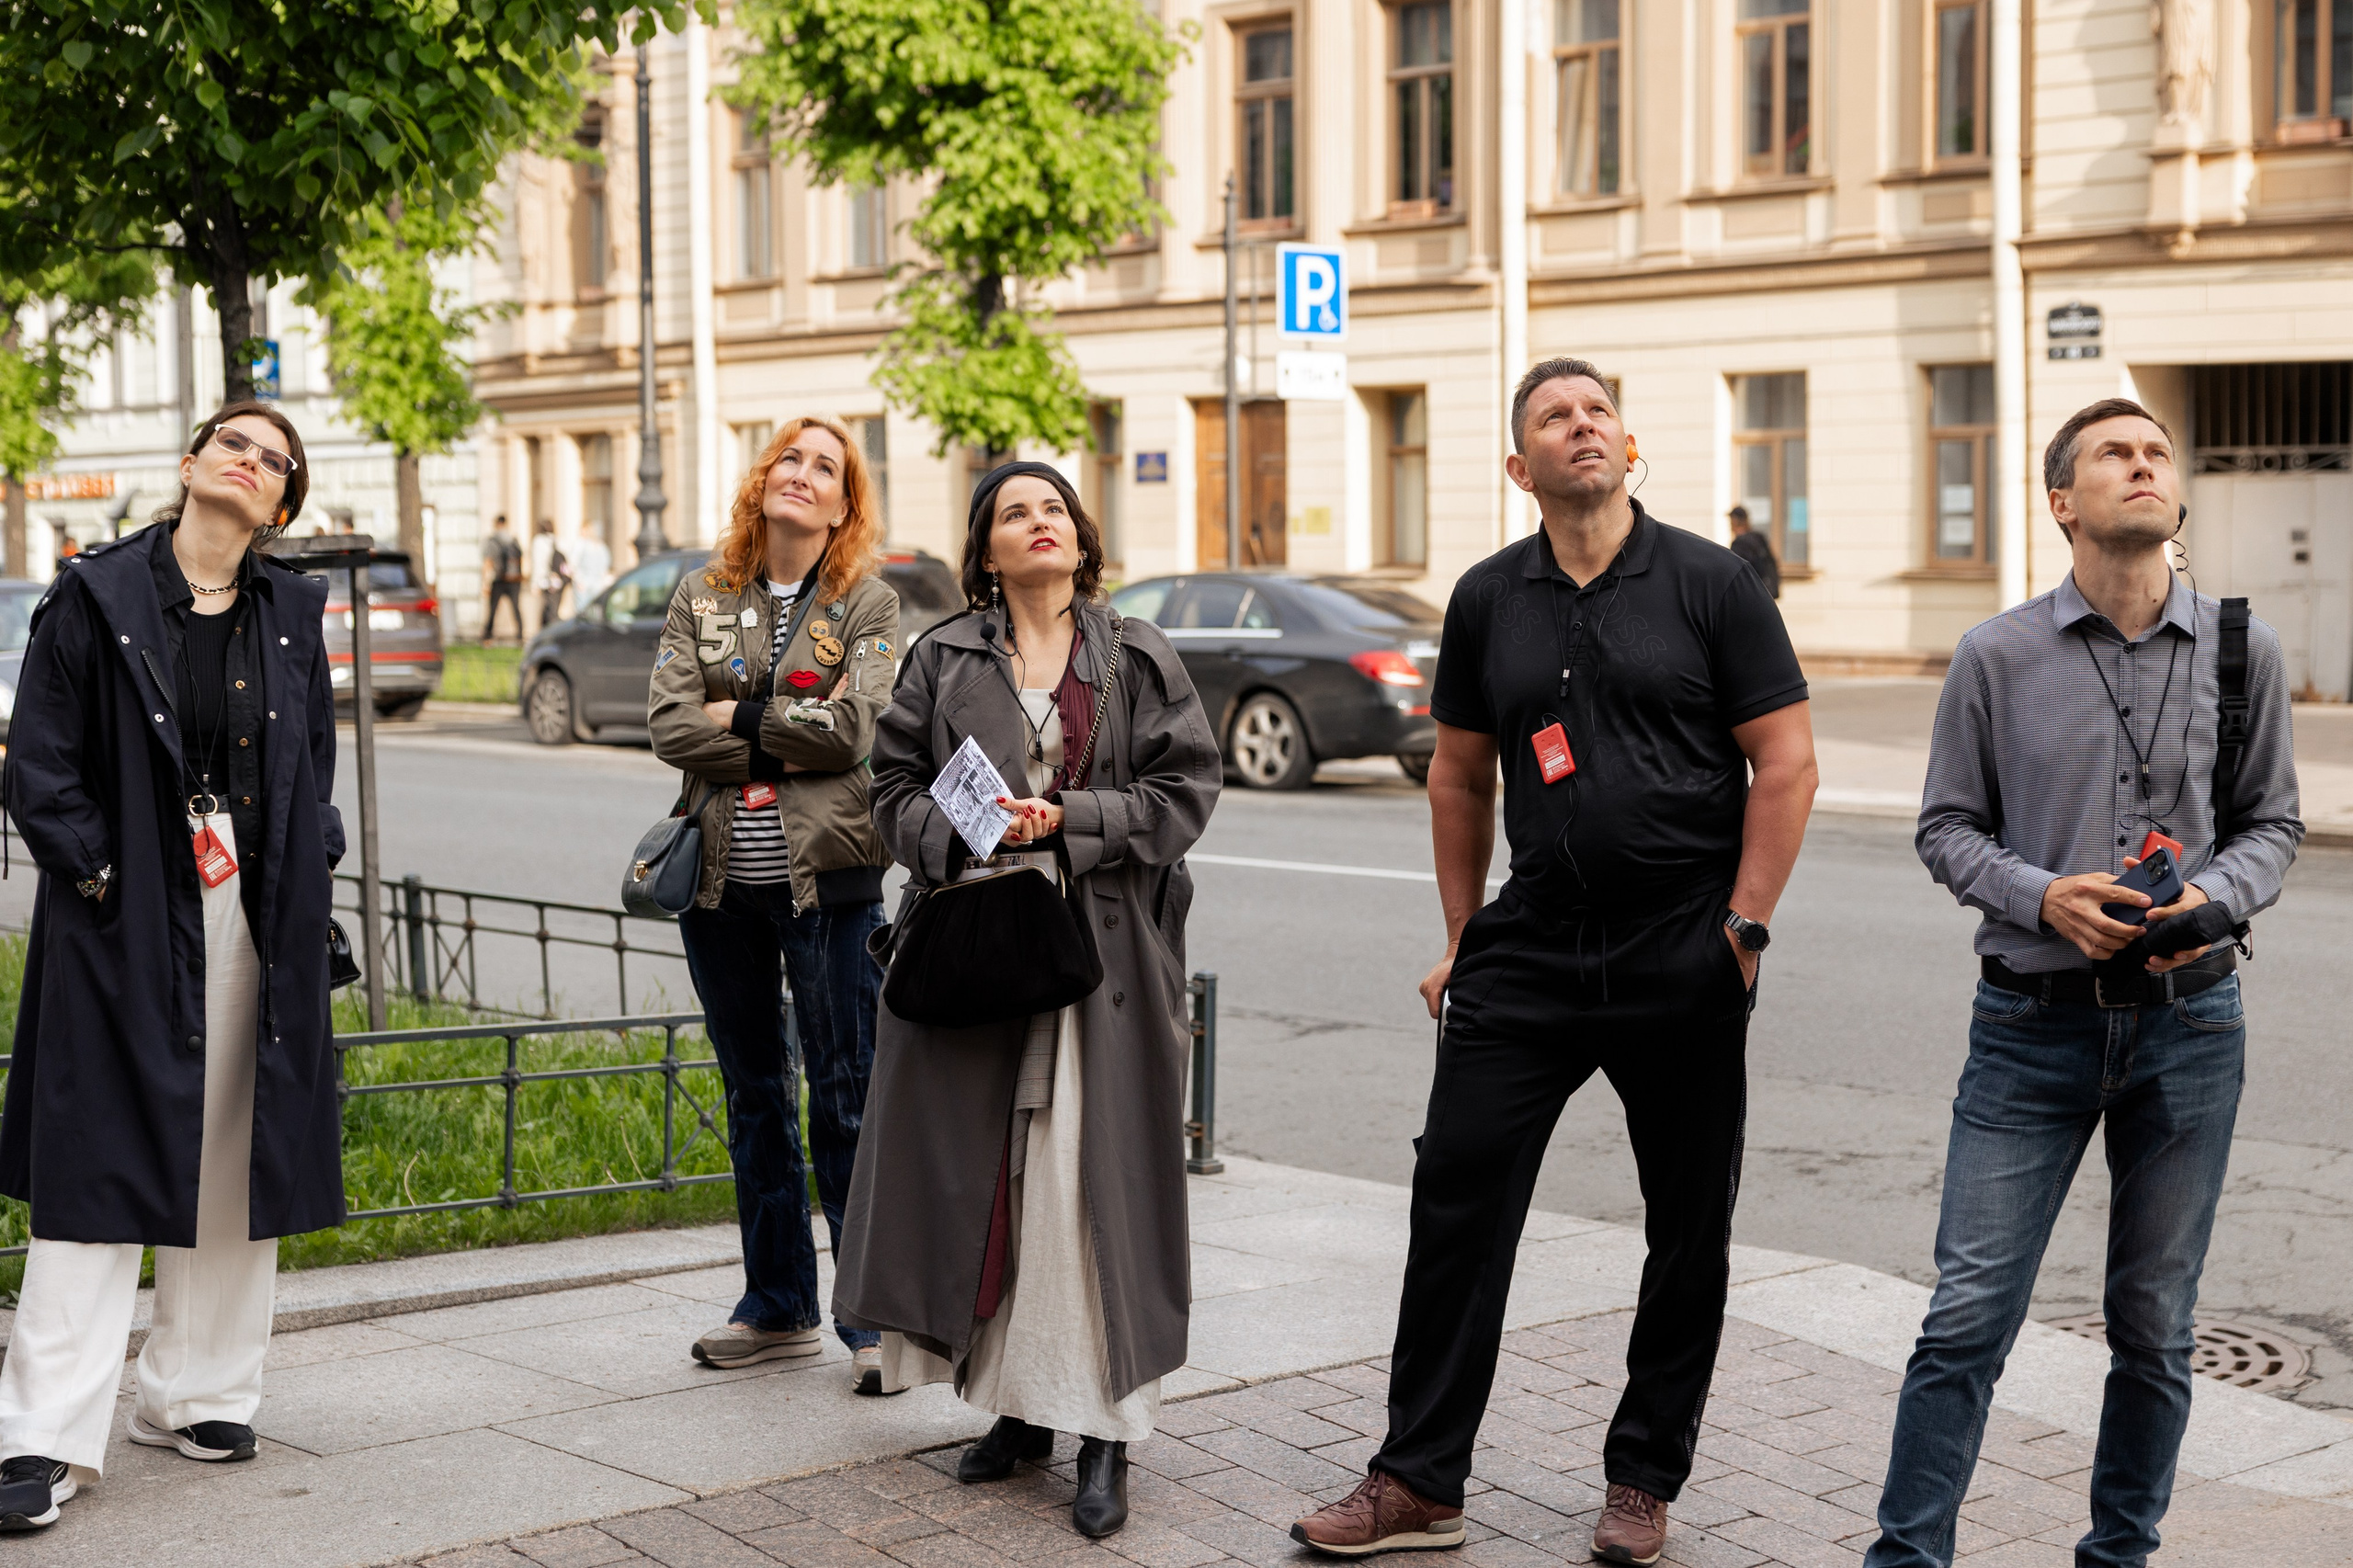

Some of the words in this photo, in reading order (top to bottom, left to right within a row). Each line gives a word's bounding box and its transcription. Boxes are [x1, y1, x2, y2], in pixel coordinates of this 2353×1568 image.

[1296, 255, 1336, 330] P
[697, 613, 738, 665] 5
[1591, 590, 1667, 666] OSS
